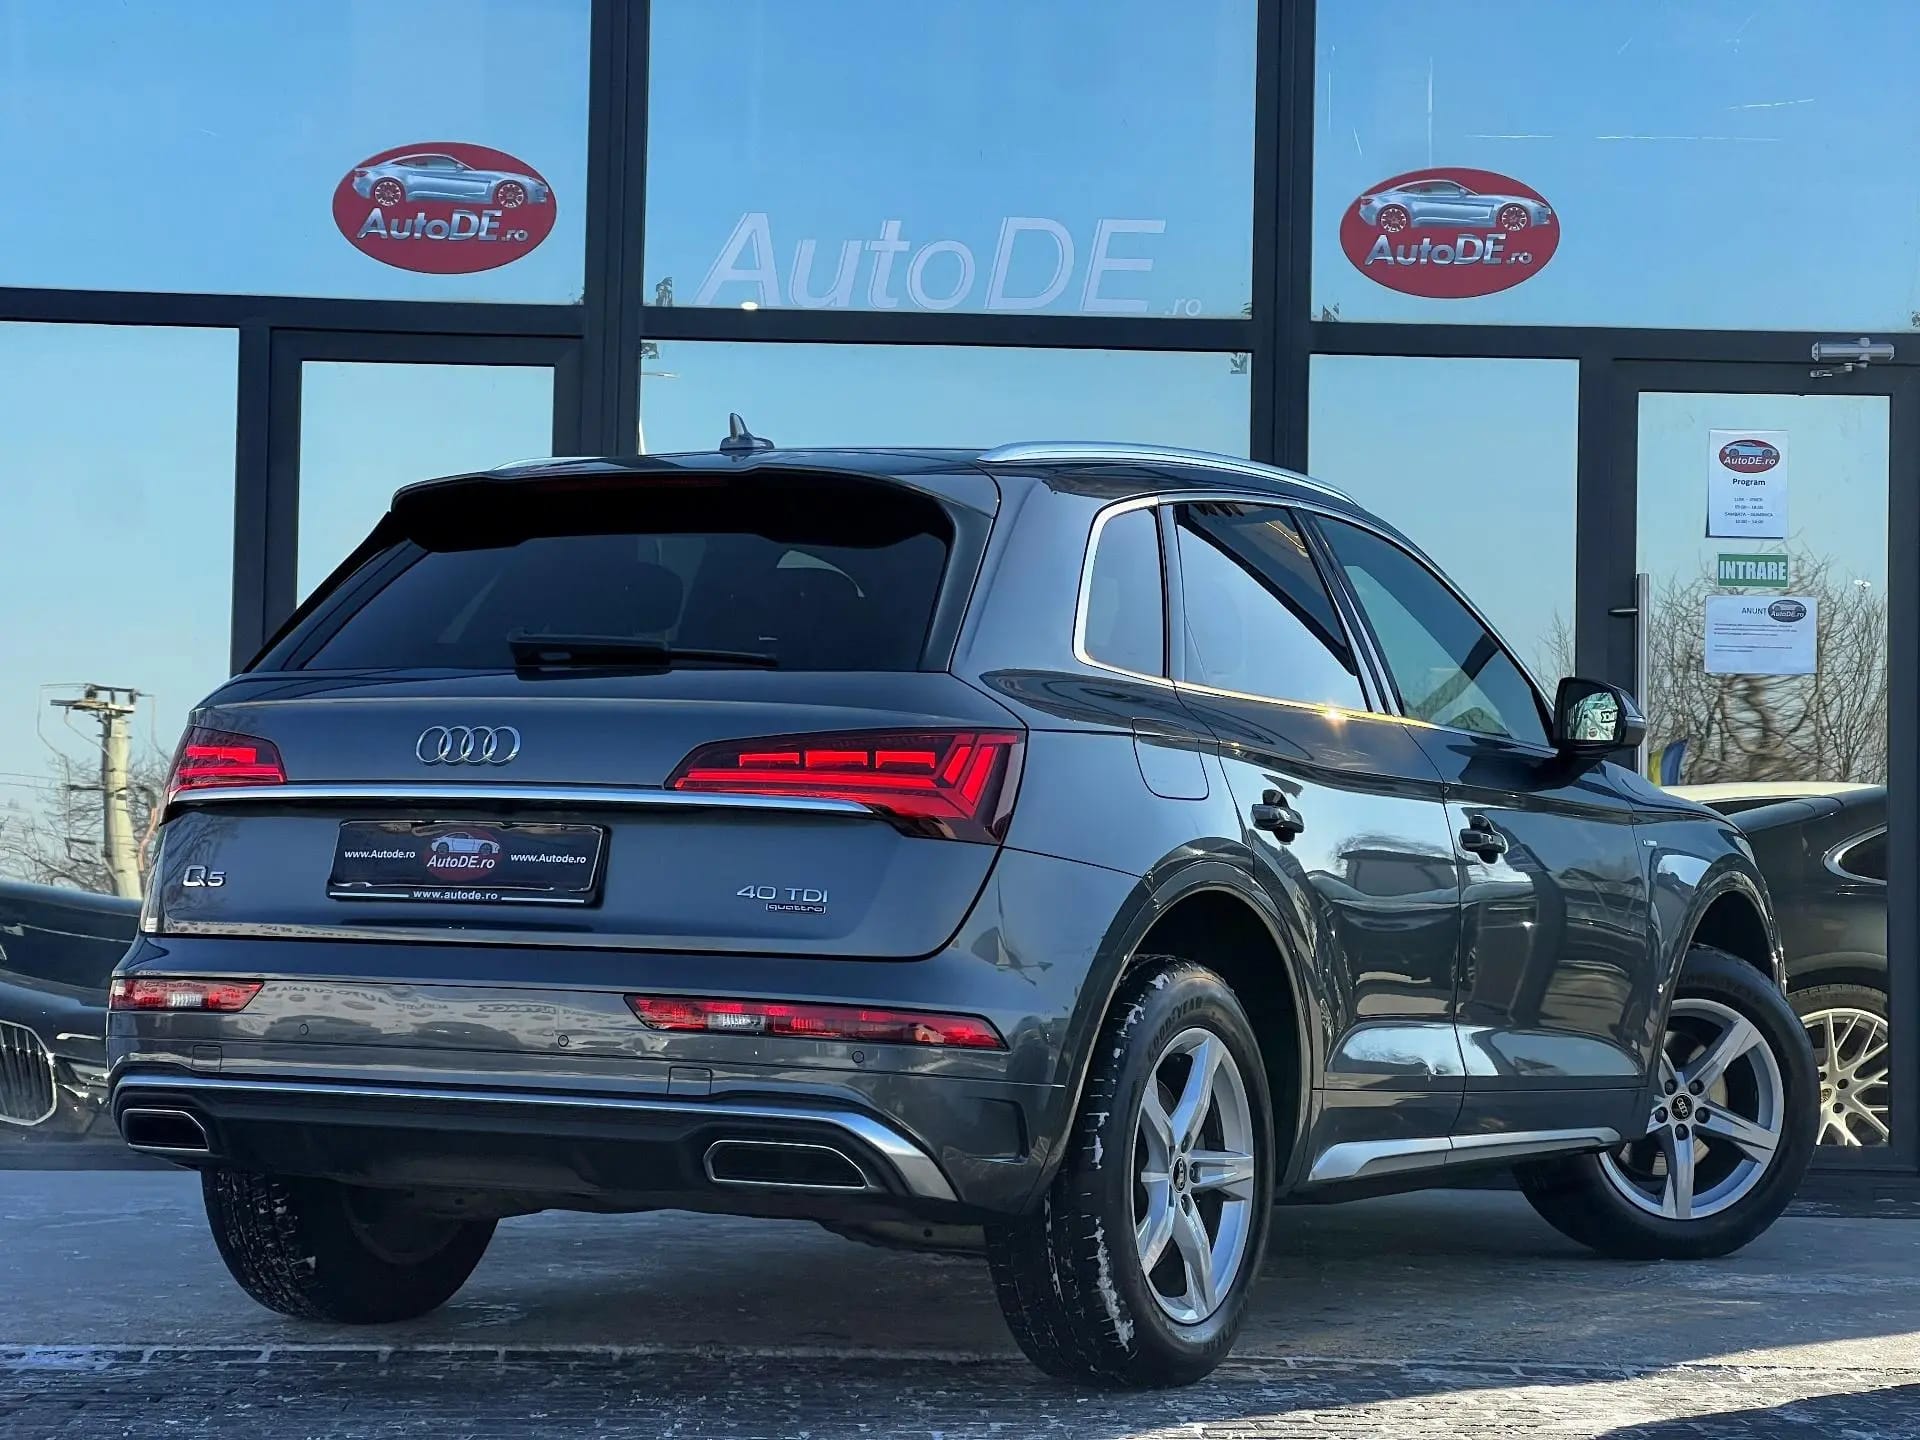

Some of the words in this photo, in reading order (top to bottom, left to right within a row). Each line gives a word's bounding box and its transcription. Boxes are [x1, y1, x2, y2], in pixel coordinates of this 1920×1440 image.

[1723, 456, 1776, 466] AutoDE.ro
[1732, 478, 1766, 487] Program
[1719, 560, 1787, 581] INTRARE
[344, 849, 416, 859] www.Autode.ro
[510, 853, 587, 865] www.Autode.ro
[426, 855, 496, 870] AutoDE.ro
[182, 865, 226, 887] Q5
[412, 889, 498, 901] www.autode.ro
[736, 885, 777, 900] 40
[784, 888, 828, 903] TDI
[768, 904, 823, 913] quattro
